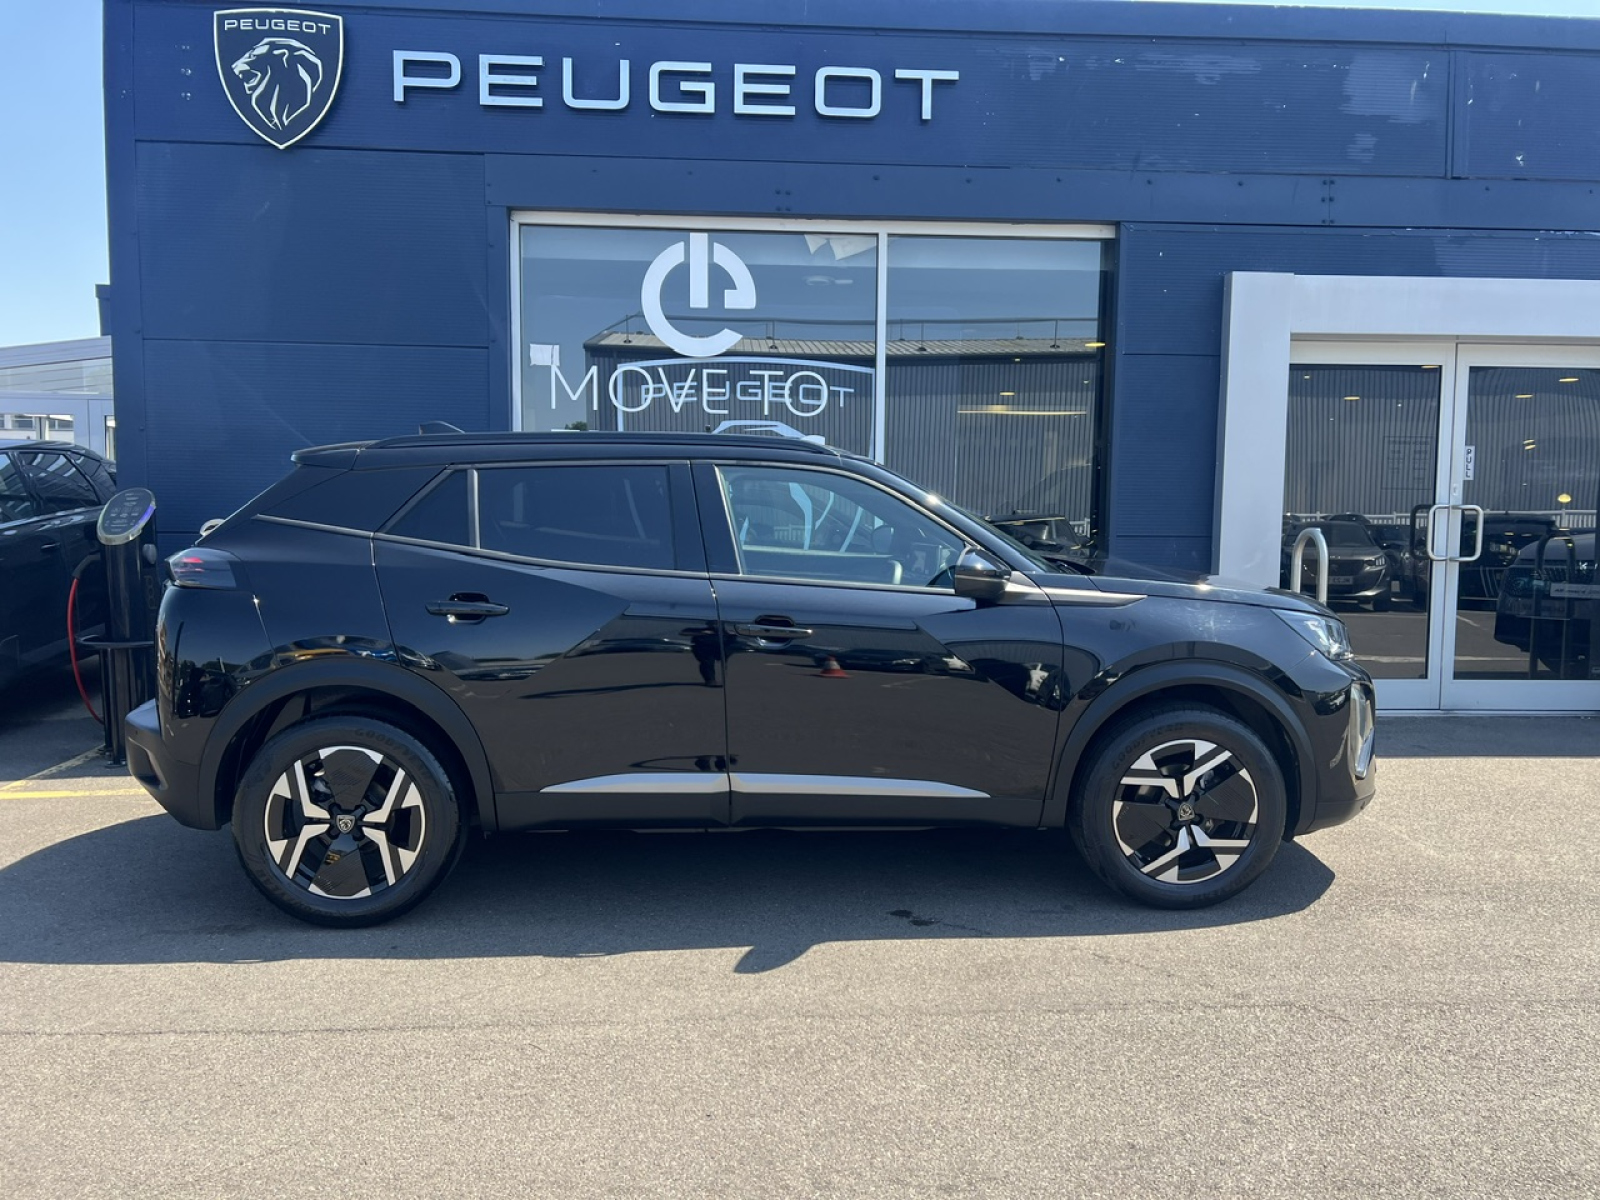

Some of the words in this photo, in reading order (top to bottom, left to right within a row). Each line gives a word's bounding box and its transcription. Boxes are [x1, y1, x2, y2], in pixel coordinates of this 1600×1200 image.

[224, 18, 331, 35] PEUGEOT
[392, 49, 960, 121] PEUGEOT
[550, 364, 729, 415] MOVE
[749, 370, 829, 417] TO
[641, 379, 855, 408] PEUGEOT
